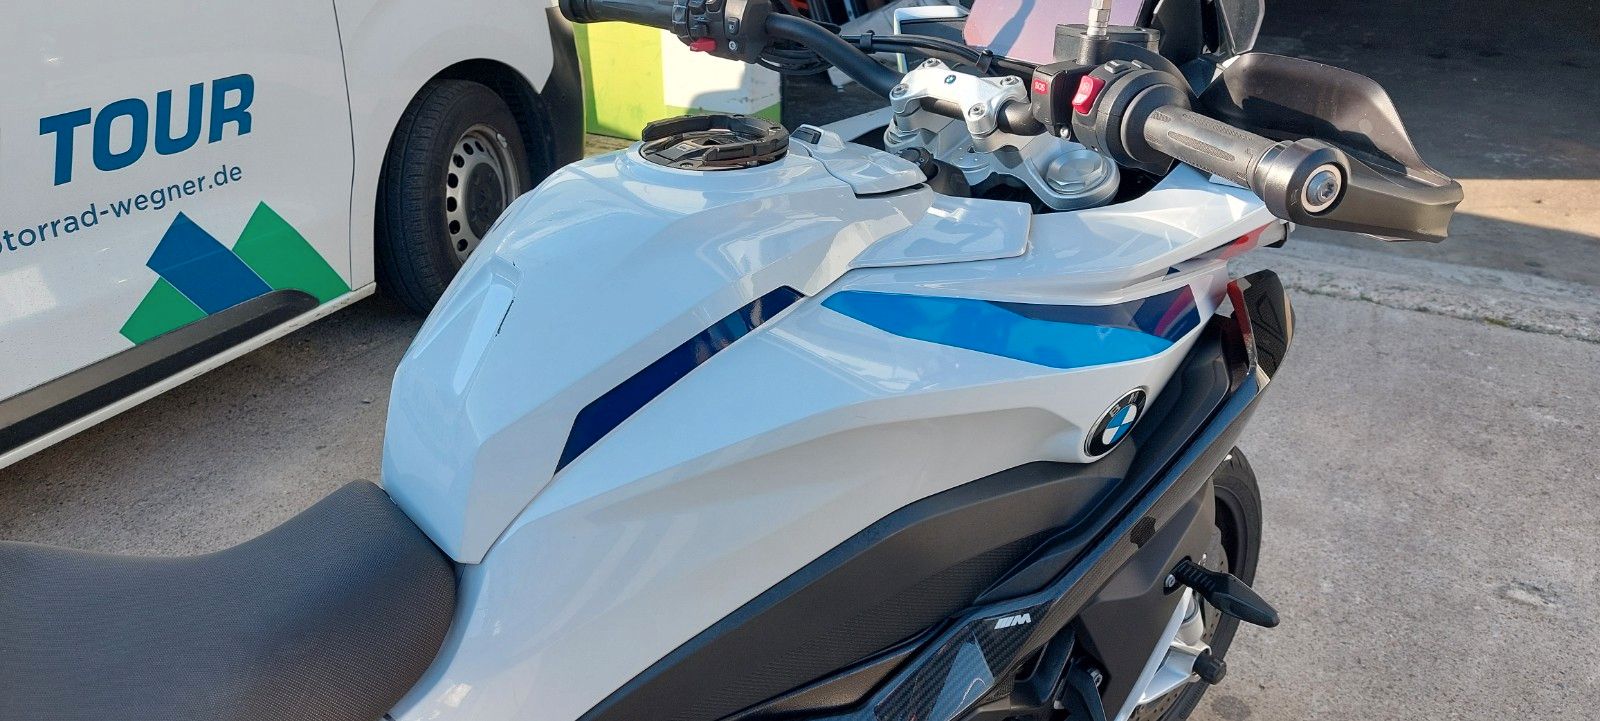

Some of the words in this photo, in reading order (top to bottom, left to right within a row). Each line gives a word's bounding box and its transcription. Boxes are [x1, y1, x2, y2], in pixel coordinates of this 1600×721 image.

[39, 73, 255, 186] TOUR
[1034, 81, 1046, 92] SOS
[0, 164, 243, 253] torrad-wegner.de
